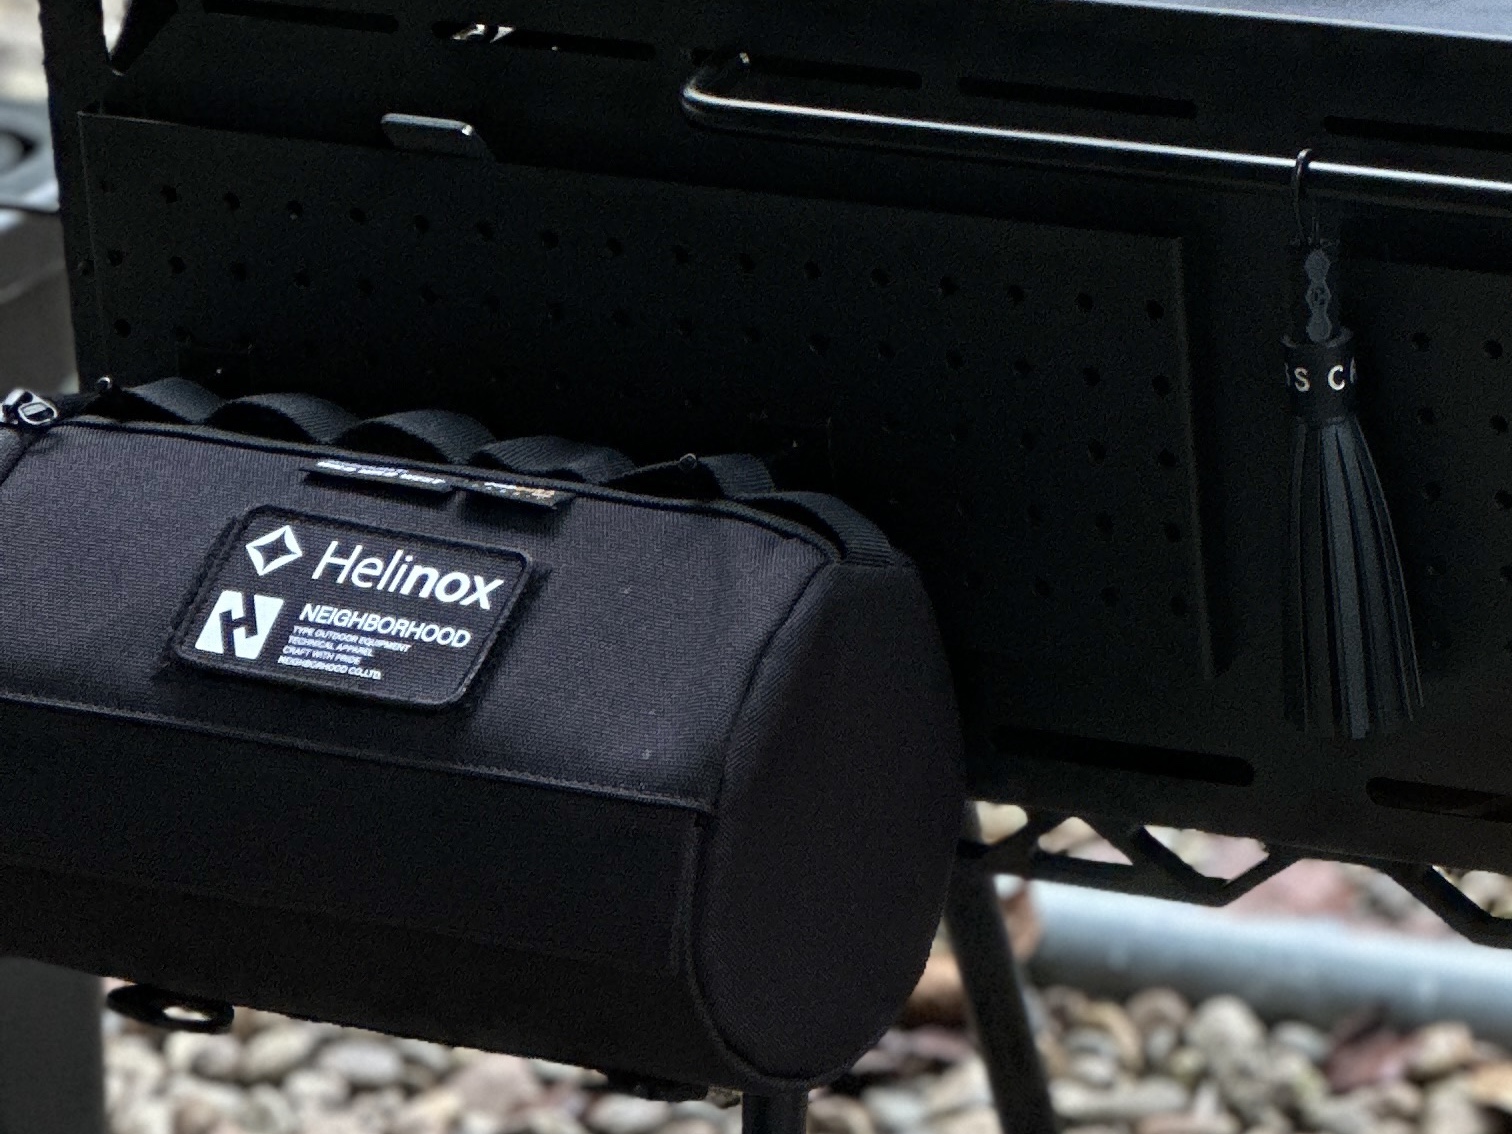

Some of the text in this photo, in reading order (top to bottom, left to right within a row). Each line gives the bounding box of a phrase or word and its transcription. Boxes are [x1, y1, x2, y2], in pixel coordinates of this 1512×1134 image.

[311, 540, 505, 611] Helinox
[293, 625, 413, 653] TYPE OUTDOOR EQUIPMENT
[299, 603, 472, 649] NEIGHBORHOOD
